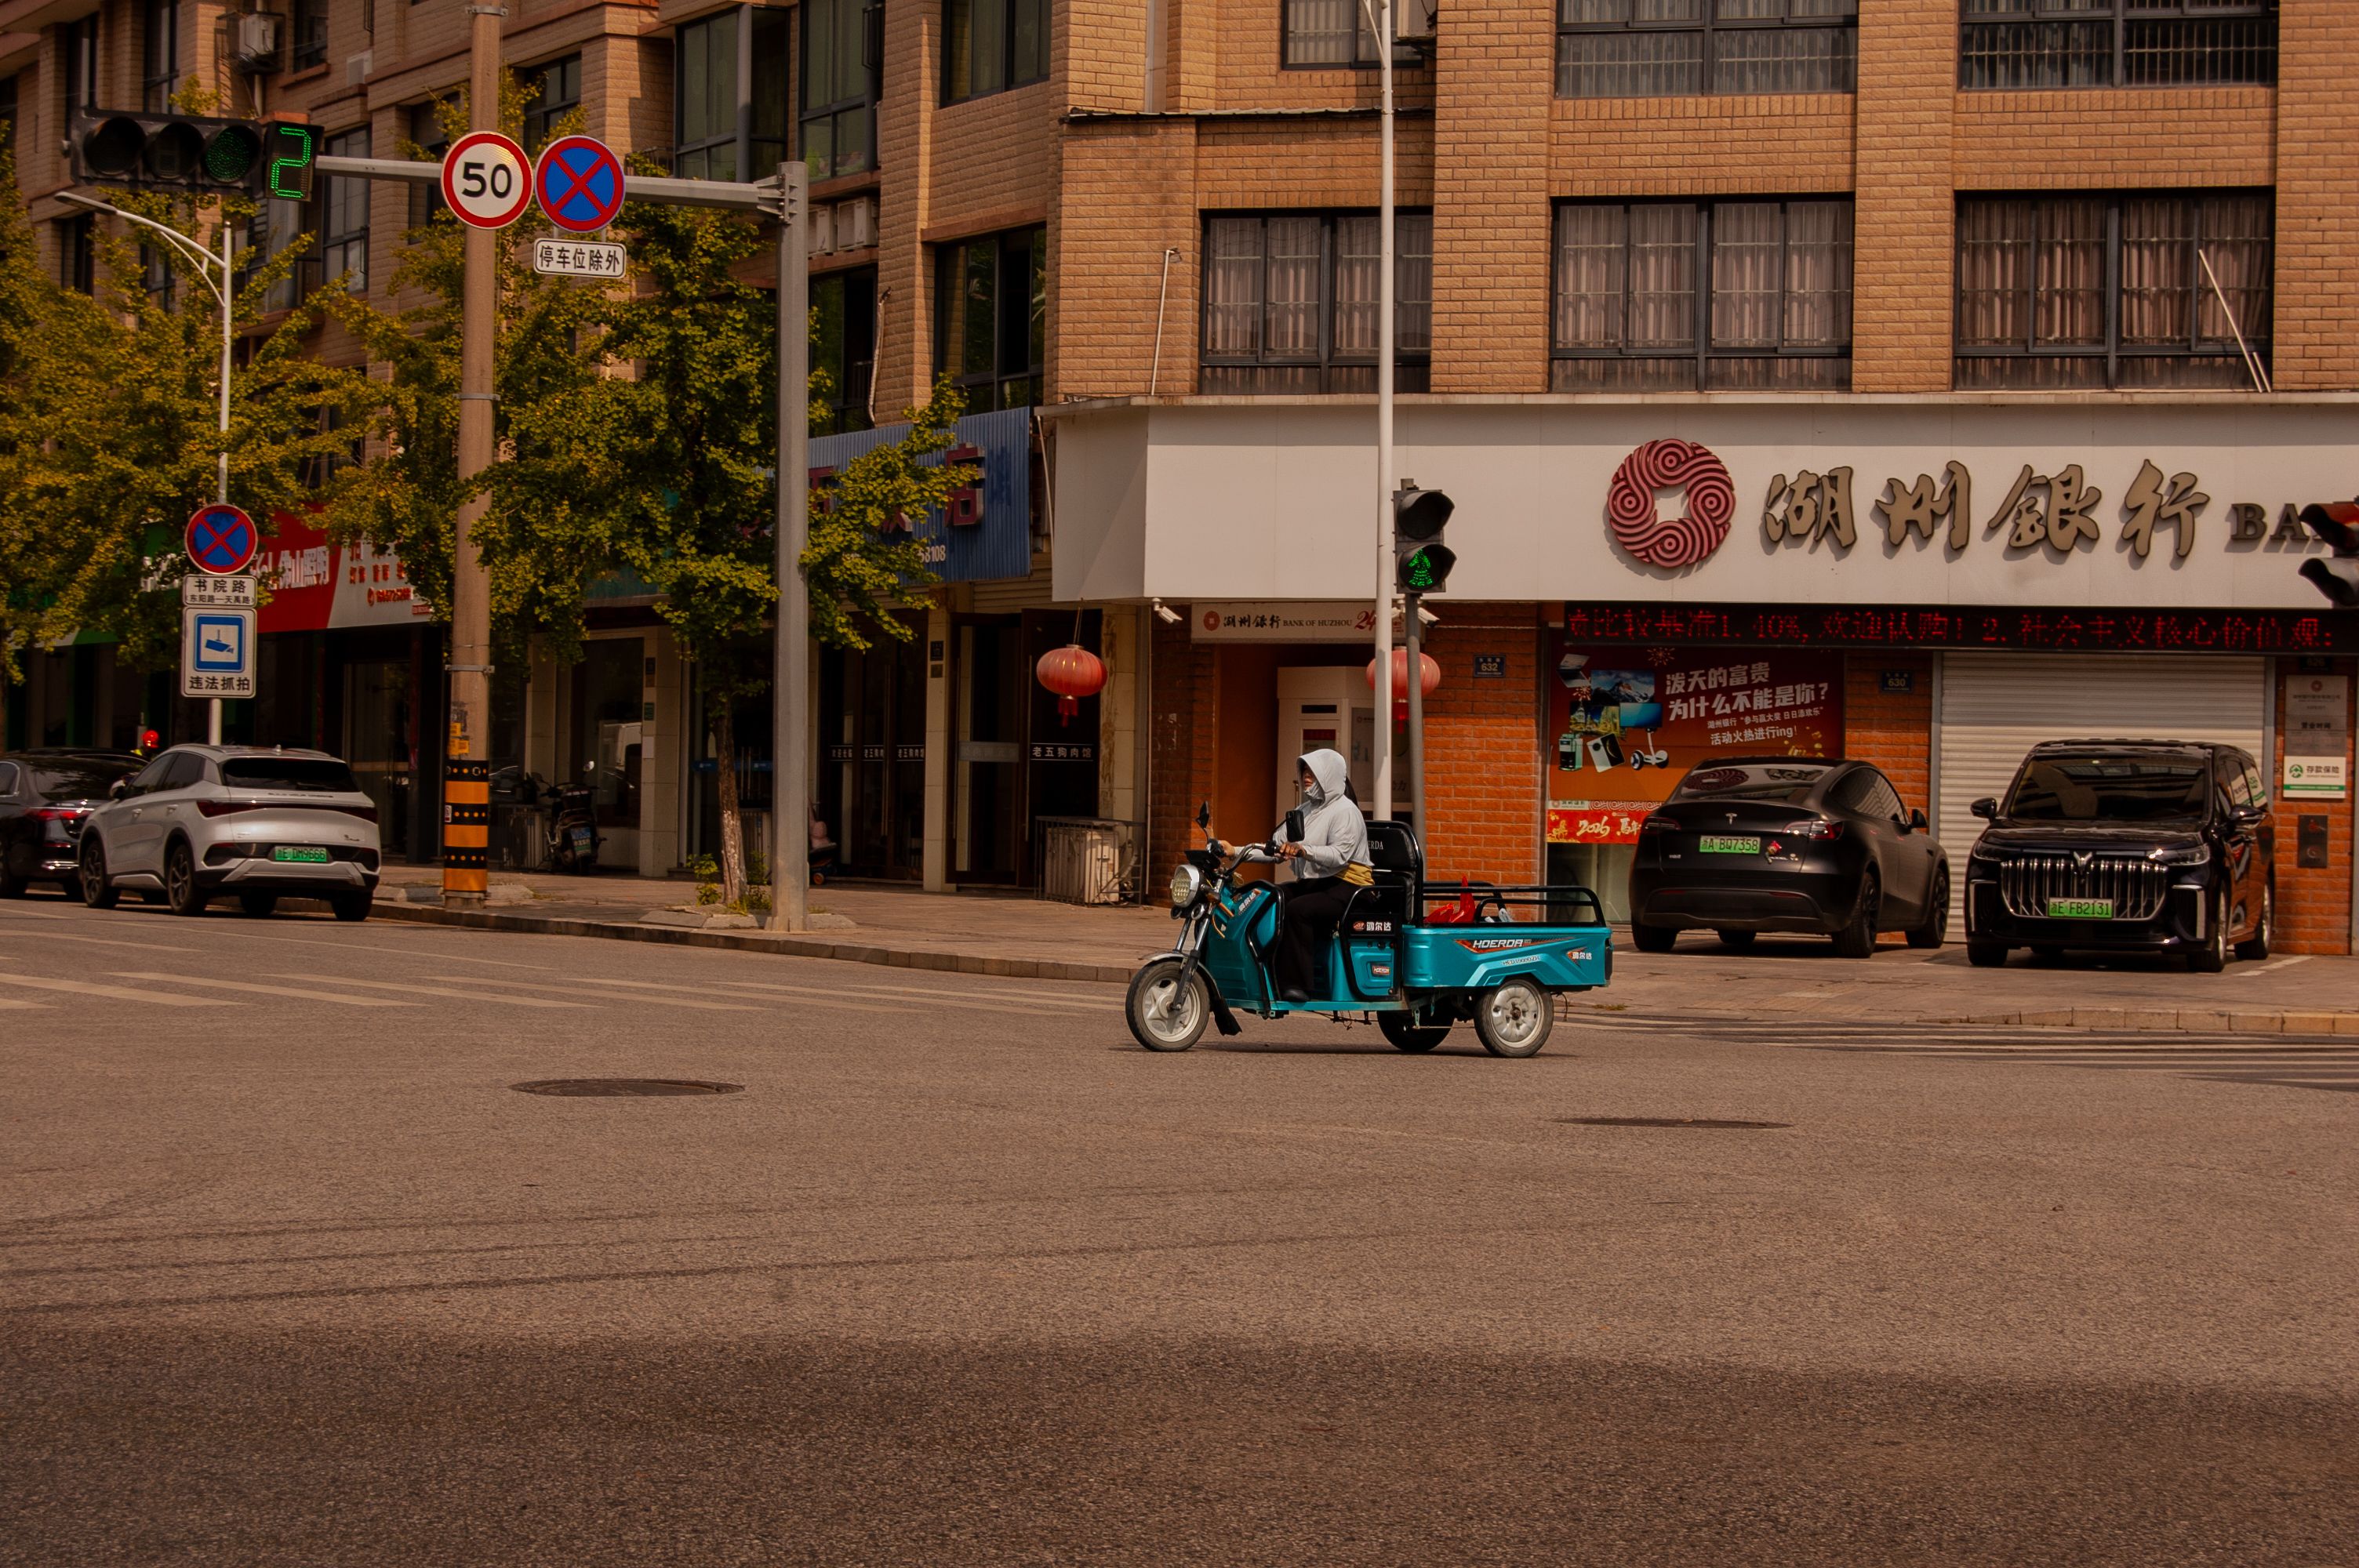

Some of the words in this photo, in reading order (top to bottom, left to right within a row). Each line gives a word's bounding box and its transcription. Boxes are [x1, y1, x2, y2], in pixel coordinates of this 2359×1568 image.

[271, 126, 313, 200] 2
[462, 162, 513, 199] 50
[540, 245, 621, 274] 停车位除外
[1765, 458, 2210, 558] 湖州银行
[2230, 503, 2322, 541] BA
[194, 578, 246, 594] 书院路
[1223, 613, 1281, 630] 湖州银行
[1318, 619, 1353, 627] HUZHOU
[189, 676, 251, 691] 违法抓拍
[1665, 662, 1771, 695] 泼天的富贵
[1031, 746, 1092, 758] 老五狗肉馆
[2306, 765, 2340, 774] 存款保险
[1719, 838, 1758, 852] BQ7358
[2069, 902, 2110, 916] FB2131
[1472, 939, 1524, 949] HOERDA
